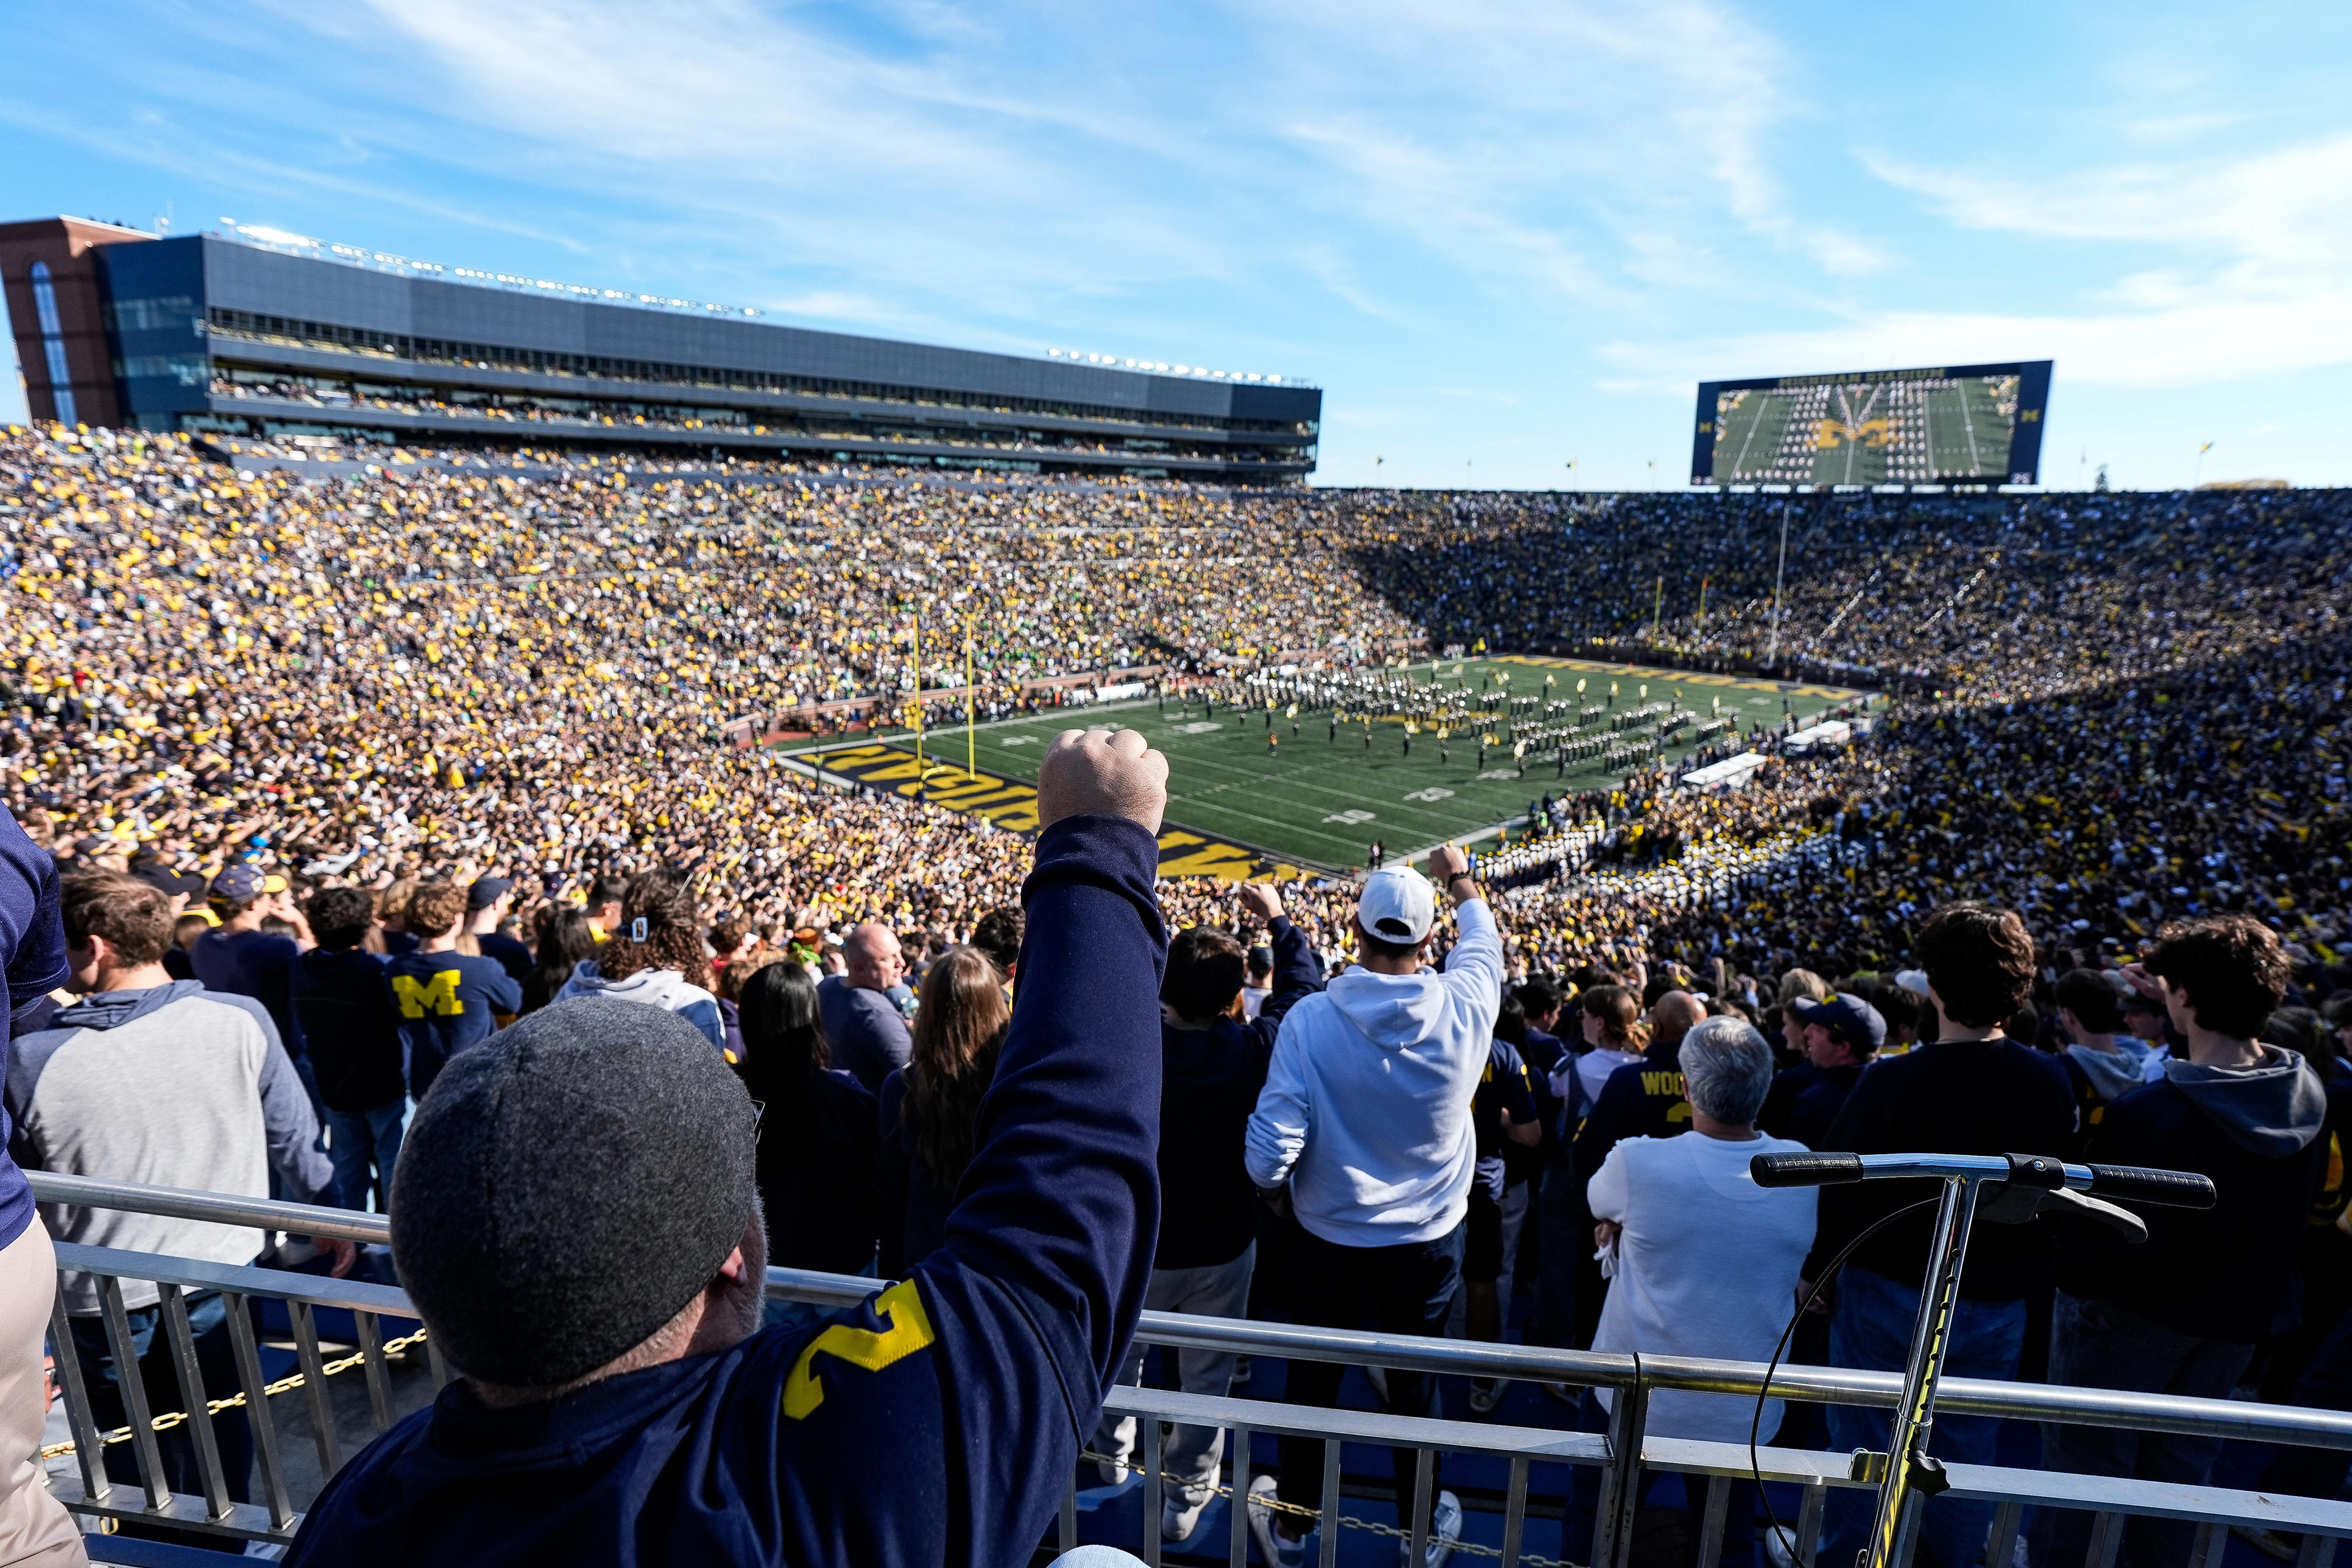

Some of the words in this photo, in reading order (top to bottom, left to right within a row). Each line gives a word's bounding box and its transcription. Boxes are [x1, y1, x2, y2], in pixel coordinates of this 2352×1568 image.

[1779, 372, 1861, 387] MICHIGAN
[391, 969, 464, 1018] M
[1640, 1071, 1684, 1095] WOO
[783, 1277, 935, 1420] 2
